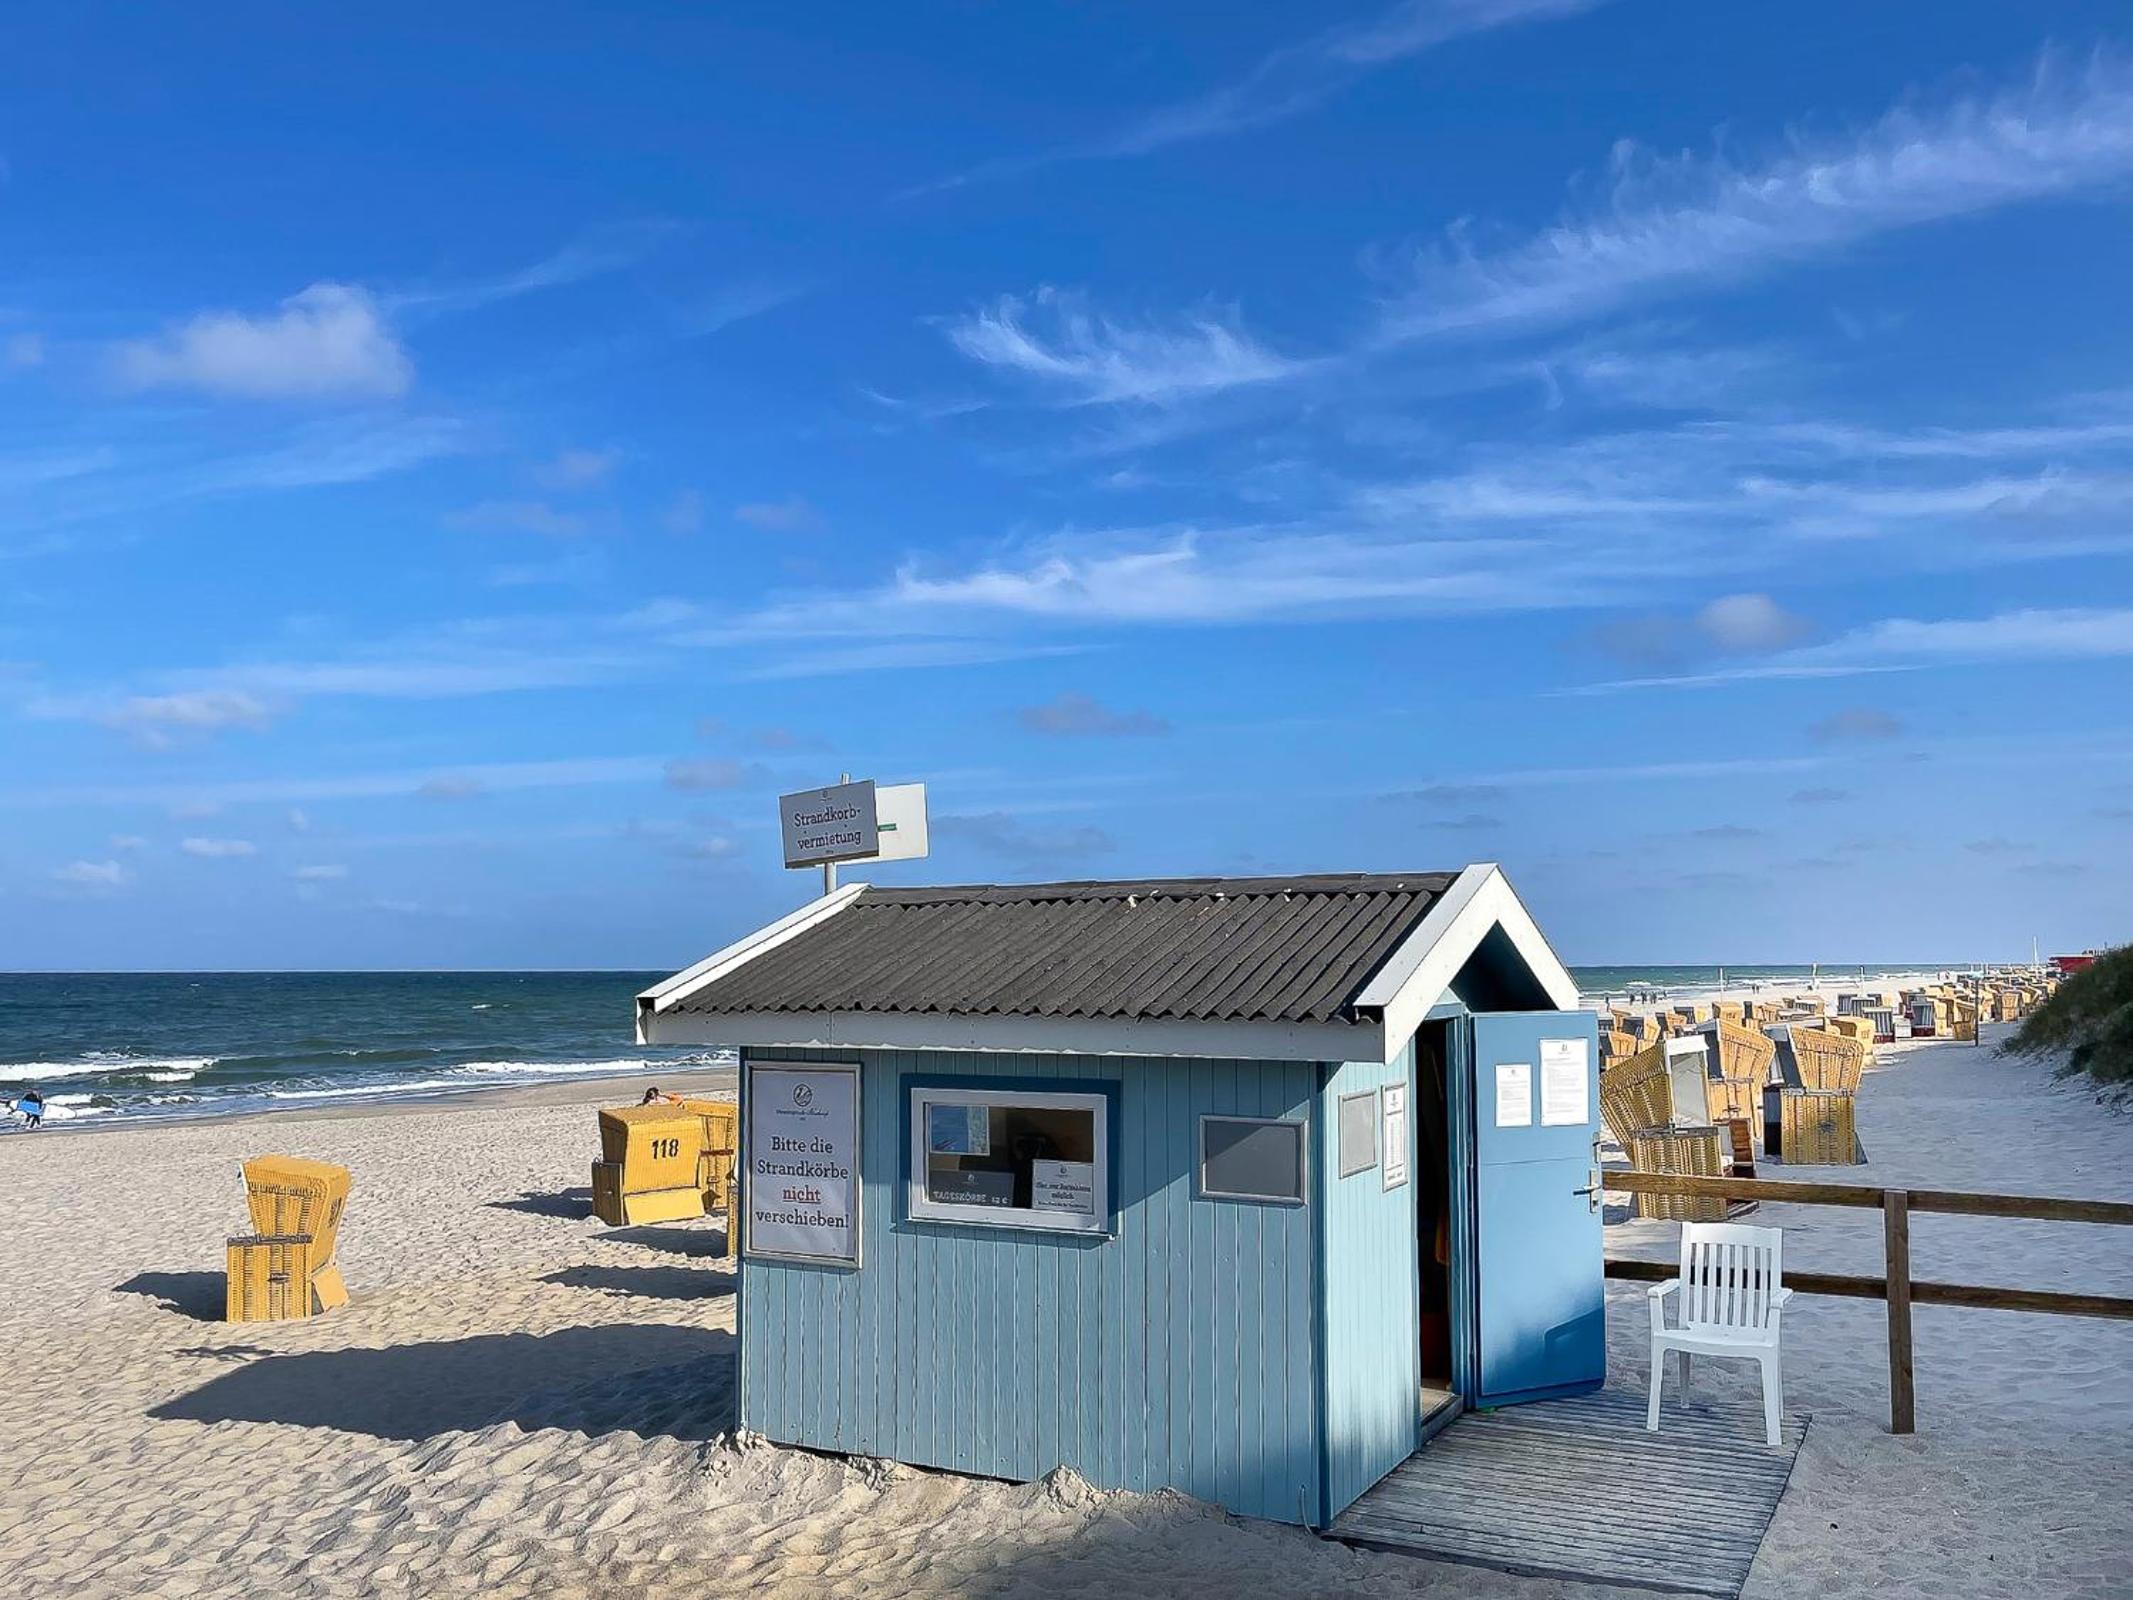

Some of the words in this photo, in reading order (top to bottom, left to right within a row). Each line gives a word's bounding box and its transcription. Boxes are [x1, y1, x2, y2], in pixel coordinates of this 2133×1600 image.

[794, 803, 861, 827] Strandkorb-
[797, 831, 862, 849] vermietung
[652, 1138, 679, 1160] 118
[771, 1136, 807, 1153] Bitte
[810, 1137, 833, 1154] die
[757, 1159, 849, 1179] Strandkörbe
[783, 1185, 821, 1202] nicht
[755, 1209, 849, 1228] verschieben!
